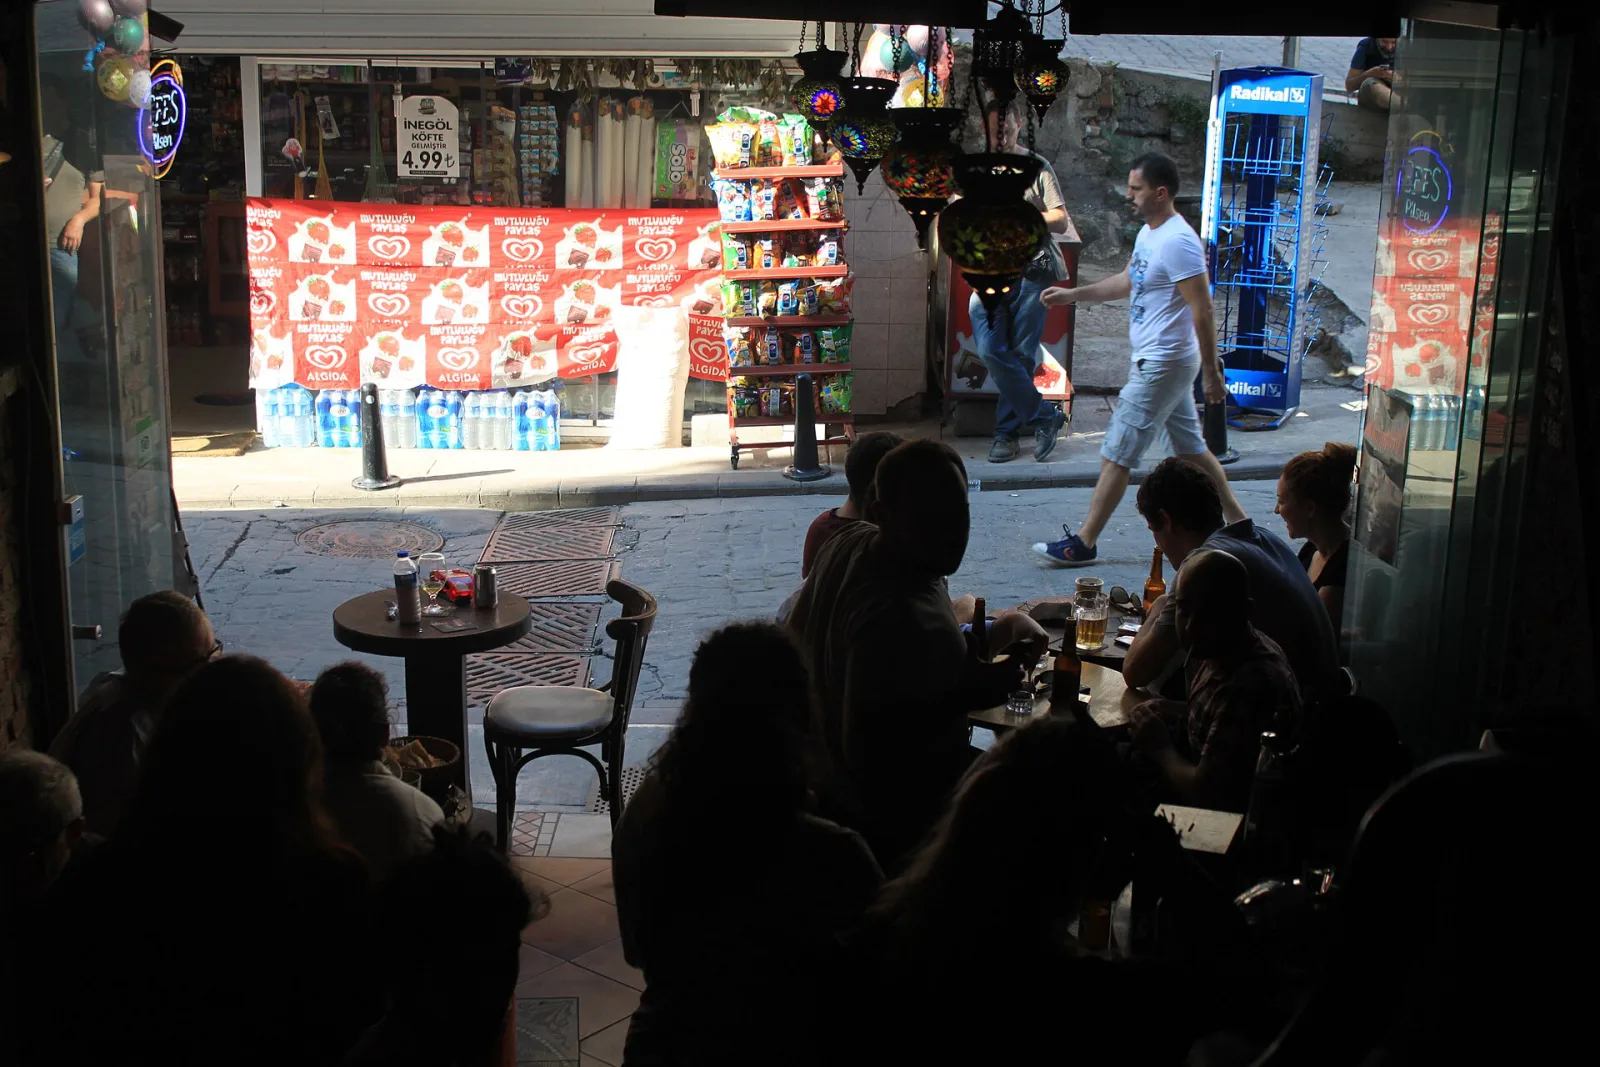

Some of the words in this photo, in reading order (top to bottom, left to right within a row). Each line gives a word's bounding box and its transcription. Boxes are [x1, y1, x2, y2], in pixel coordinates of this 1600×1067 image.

[1231, 85, 1289, 102] Radikal
[404, 118, 453, 130] İNEGÖL
[412, 131, 444, 141] KÖFTE
[411, 142, 447, 150] GELMİŞTİR
[670, 143, 687, 184] Solo
[360, 213, 416, 224] MUTLULUĞU
[494, 215, 549, 226] MUTLULUĞU
[628, 214, 684, 226] MUTLULUĞU
[1224, 381, 1266, 396] adikal
